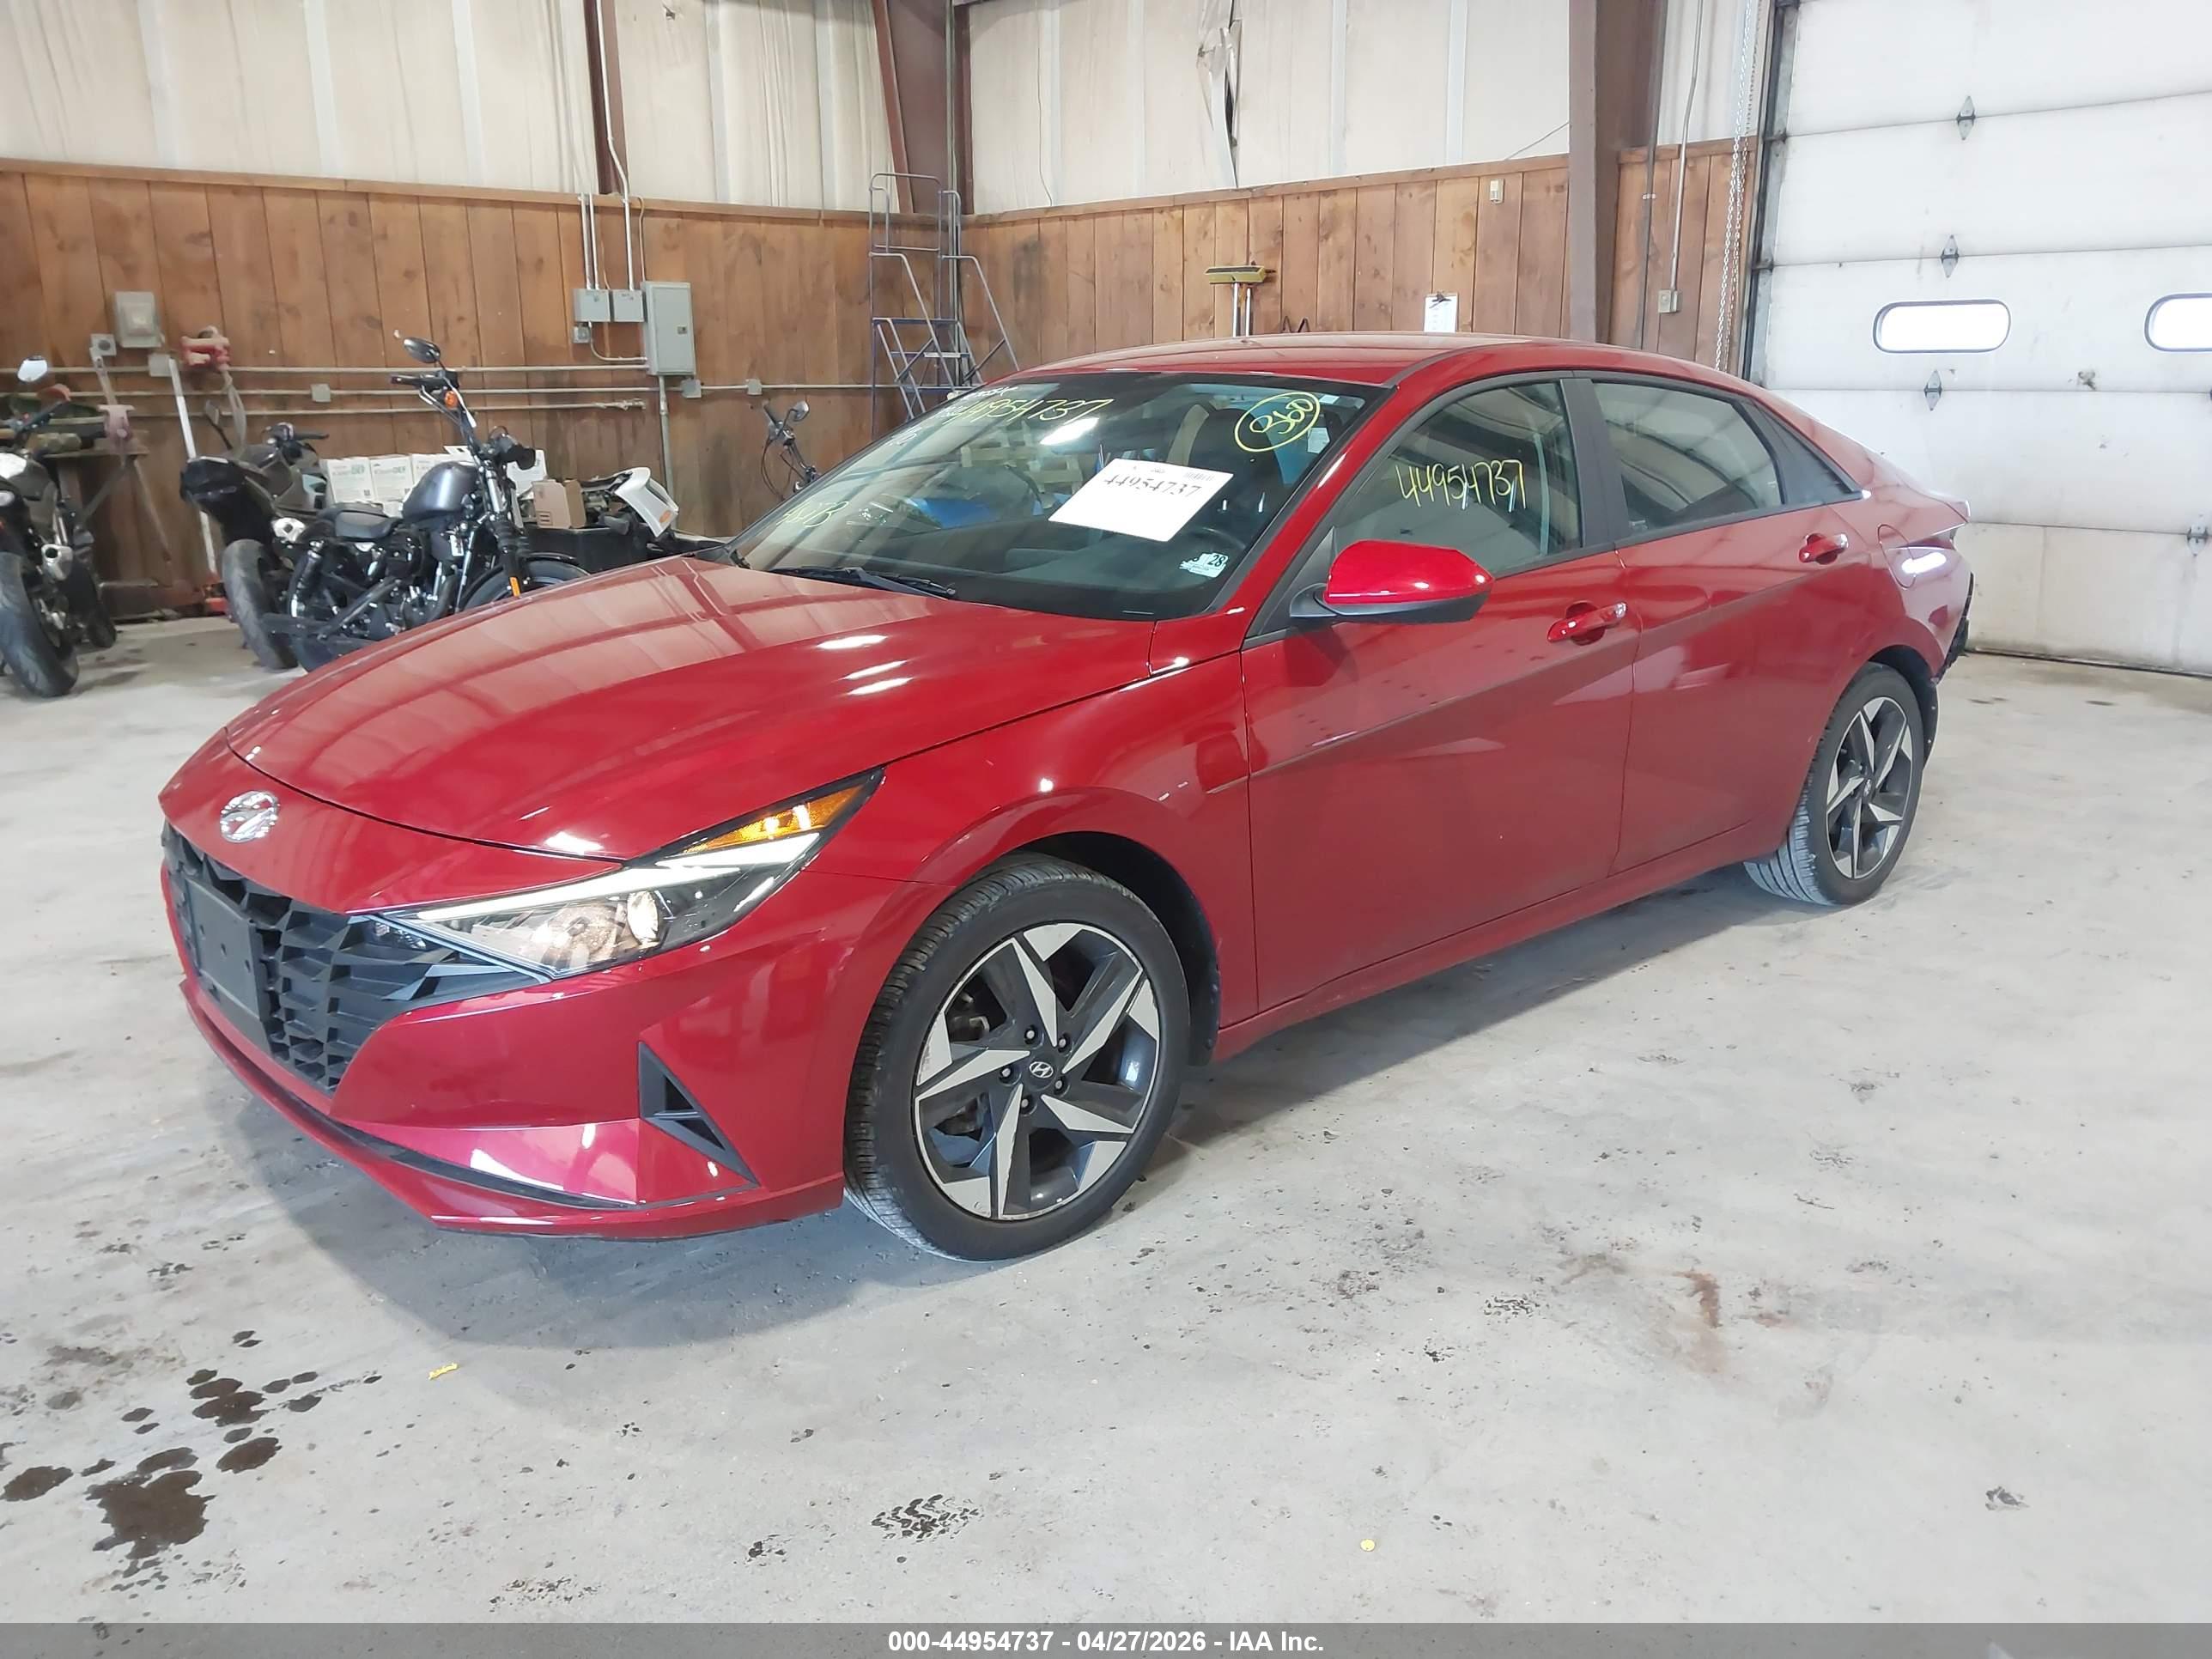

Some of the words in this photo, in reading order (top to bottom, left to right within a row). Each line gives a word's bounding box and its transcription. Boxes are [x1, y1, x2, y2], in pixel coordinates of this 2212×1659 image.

[1103, 474, 1202, 497] 44954737
[1395, 459, 1526, 510] 44954737
[1207, 554, 1226, 567] 28
